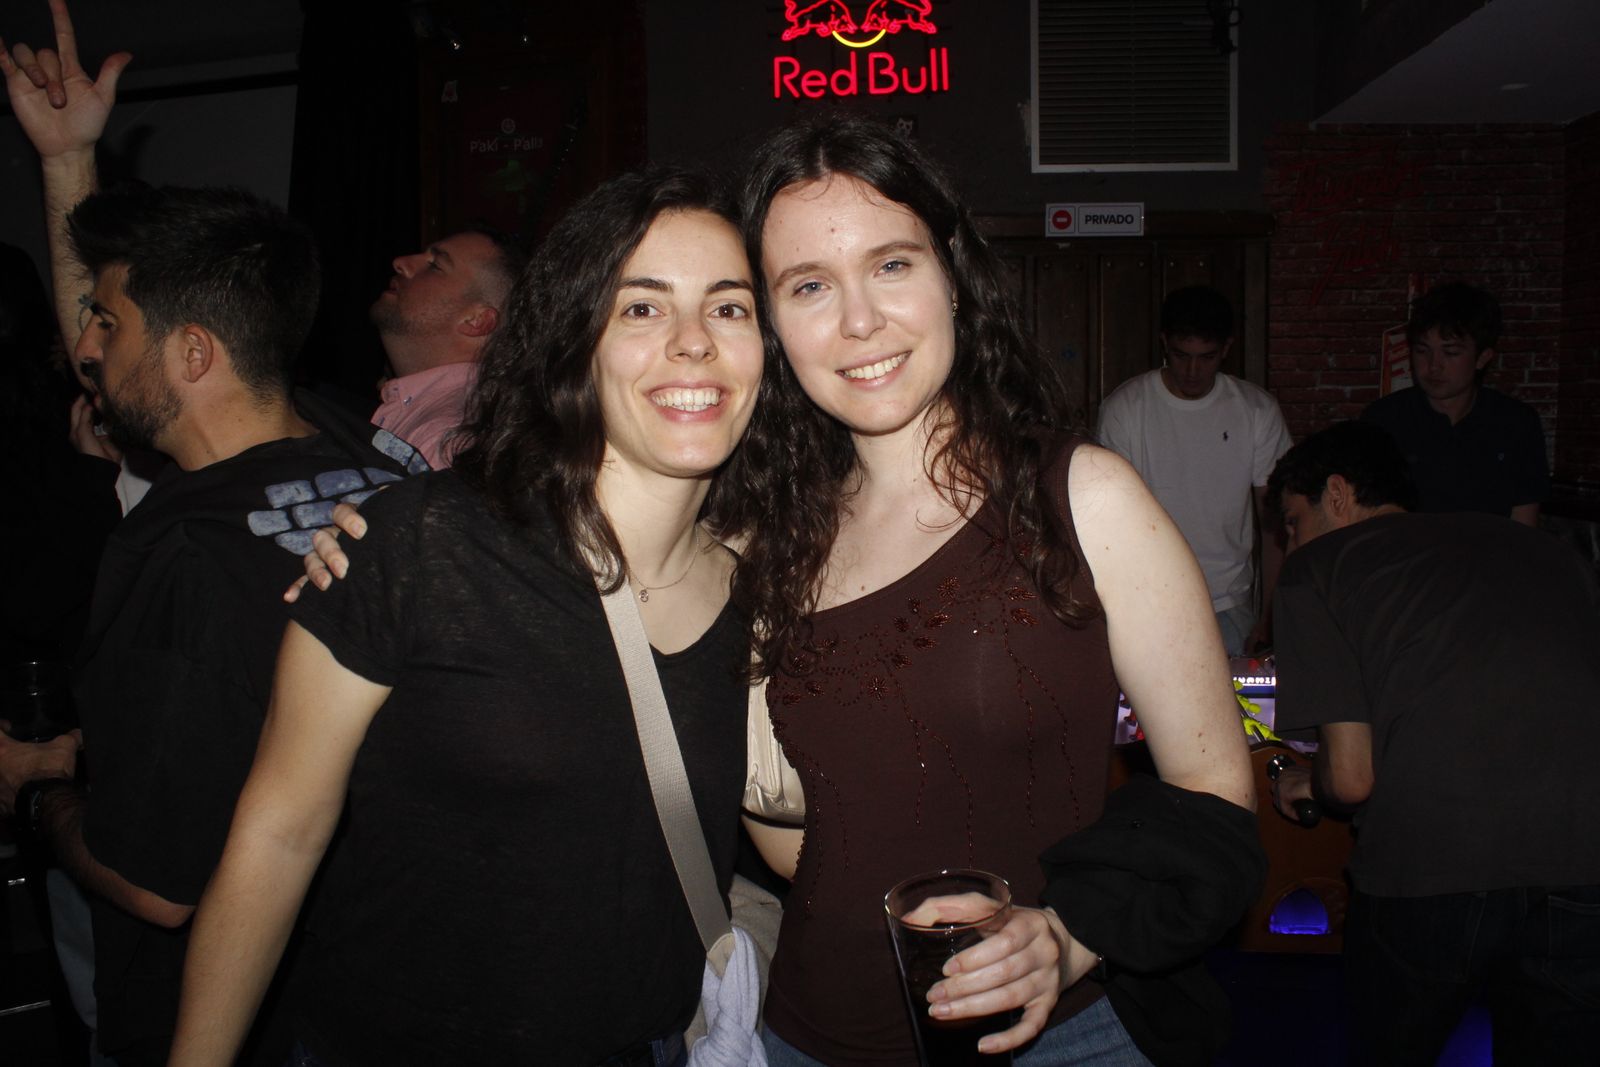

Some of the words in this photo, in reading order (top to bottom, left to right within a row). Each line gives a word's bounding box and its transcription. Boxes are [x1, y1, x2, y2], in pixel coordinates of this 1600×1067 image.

[773, 50, 858, 99] Red
[867, 47, 950, 96] Bull
[1085, 214, 1134, 225] PRIVADO
